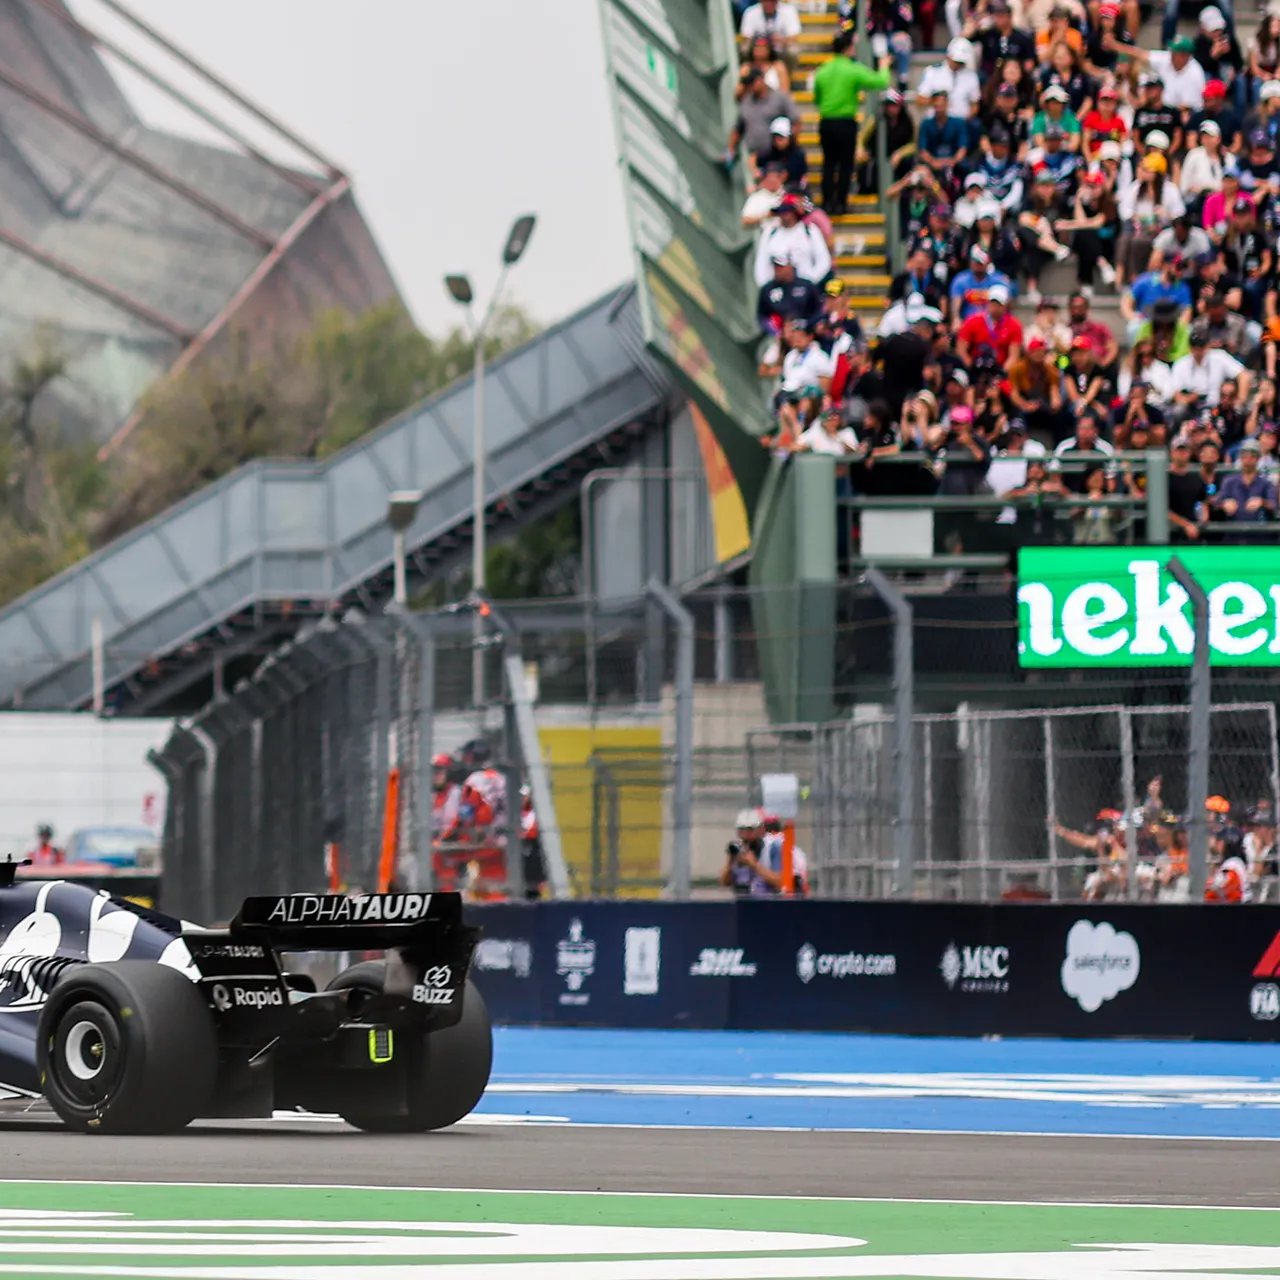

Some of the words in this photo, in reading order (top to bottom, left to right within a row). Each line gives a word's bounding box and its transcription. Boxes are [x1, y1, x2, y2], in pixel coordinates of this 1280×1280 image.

[268, 893, 432, 923] ALPHATAURI
[962, 946, 1009, 978] MSC
[234, 987, 283, 1009] Rapid
